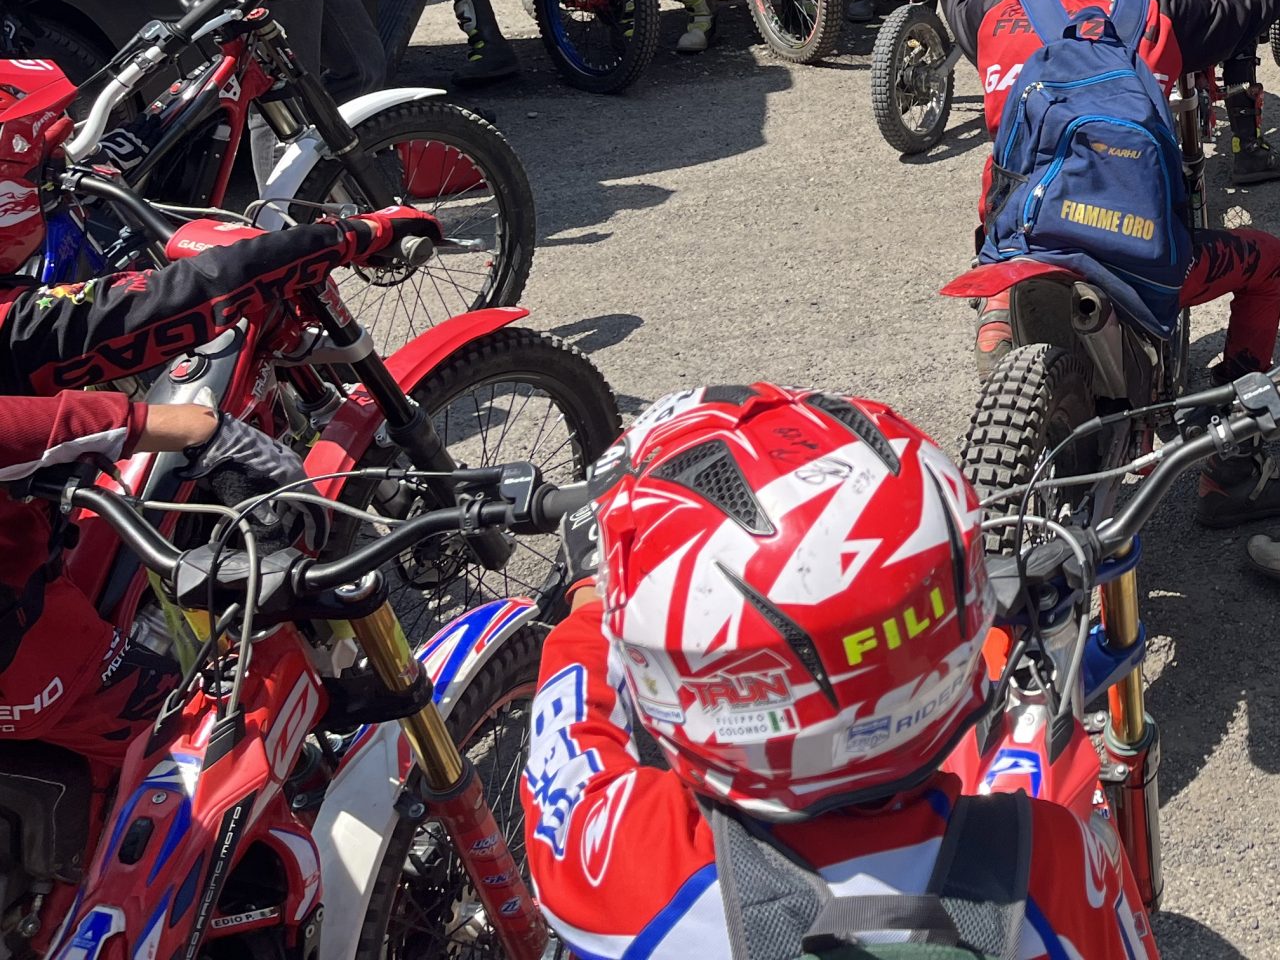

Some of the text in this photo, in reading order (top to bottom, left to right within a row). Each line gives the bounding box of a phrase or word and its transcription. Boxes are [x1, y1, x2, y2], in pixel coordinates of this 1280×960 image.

[1108, 148, 1142, 160] KARHU
[1060, 199, 1155, 241] FIAMME ORO
[177, 238, 215, 250] GASG
[842, 586, 946, 667] FILI
[716, 713, 766, 727] FILIPPO
[718, 723, 769, 738] COLOMBO
